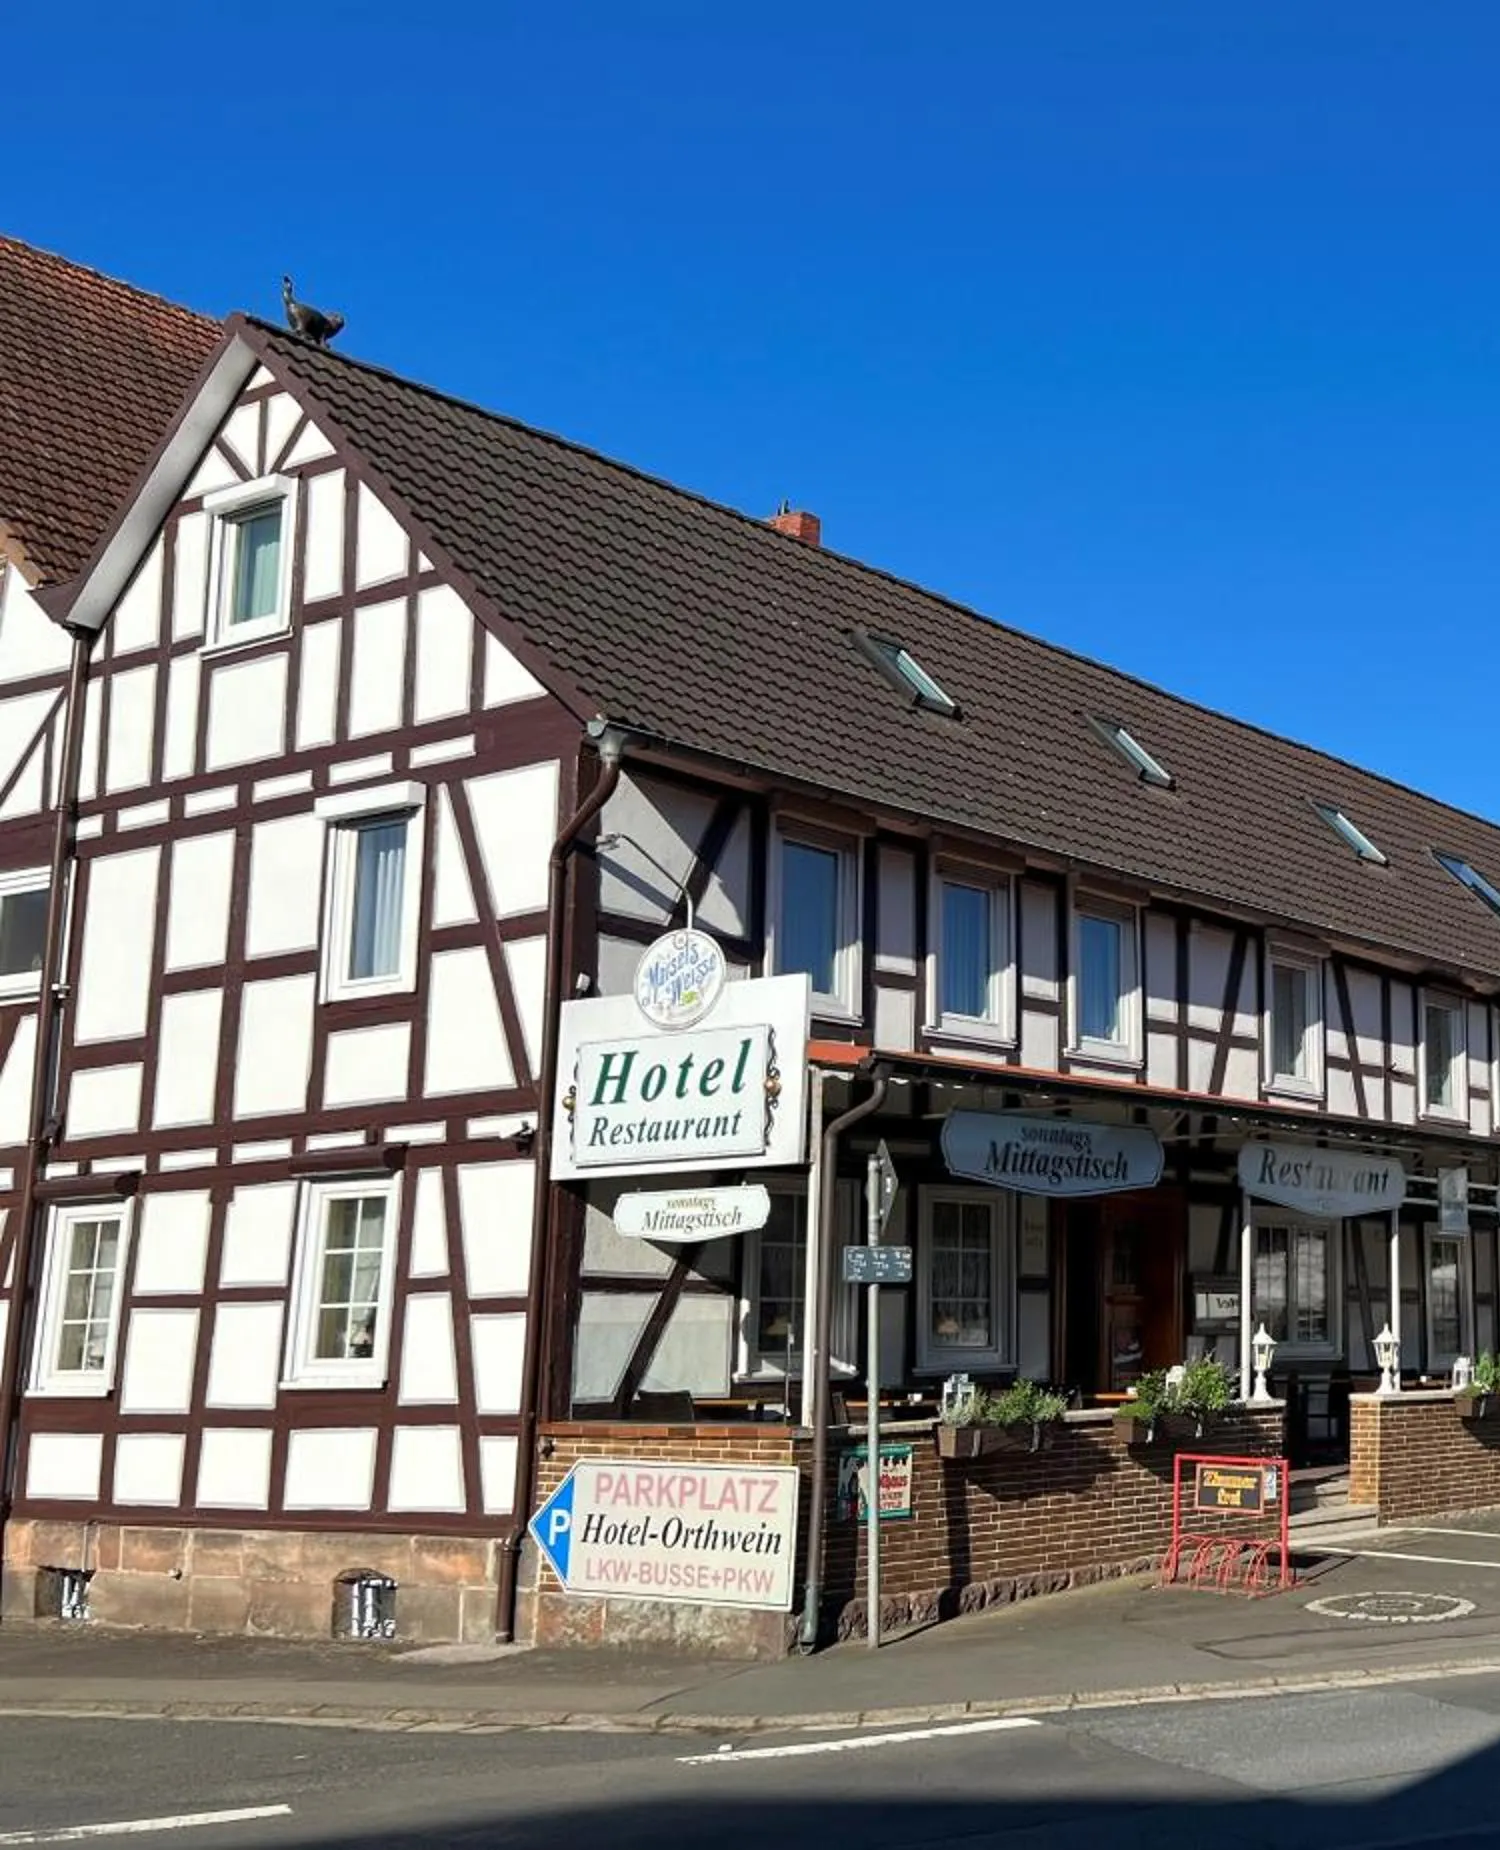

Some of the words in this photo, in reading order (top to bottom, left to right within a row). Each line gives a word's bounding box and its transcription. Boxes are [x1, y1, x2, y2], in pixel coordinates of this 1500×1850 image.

[588, 1037, 752, 1107] Hotel
[588, 1110, 742, 1147] Restaurant
[984, 1140, 1129, 1185] Mittagstisch
[641, 1205, 742, 1233] Mittagstisch
[594, 1472, 780, 1514] PARKPLATZ
[549, 1509, 570, 1546] P
[580, 1513, 782, 1555] Hotel-Orthwein
[585, 1558, 775, 1593] LKW-BUSSE+PKW
